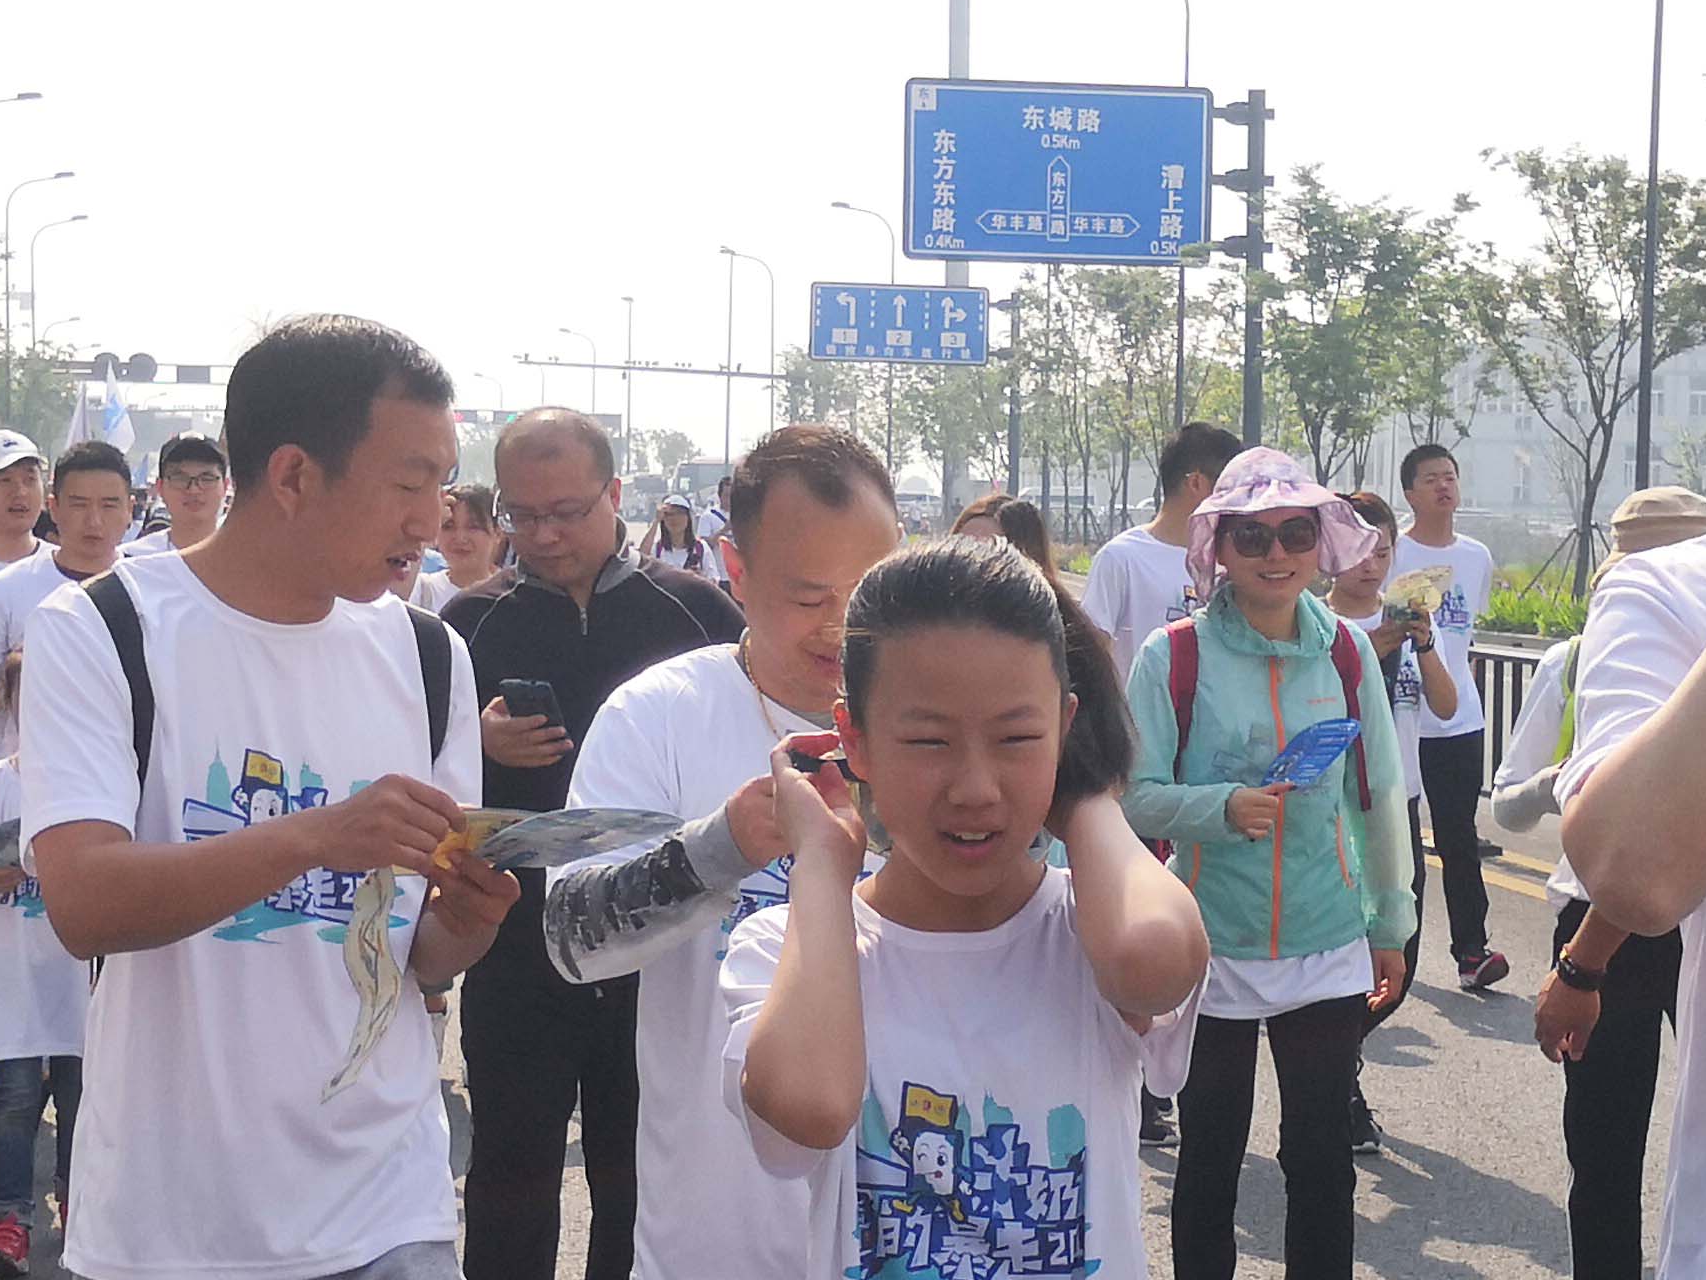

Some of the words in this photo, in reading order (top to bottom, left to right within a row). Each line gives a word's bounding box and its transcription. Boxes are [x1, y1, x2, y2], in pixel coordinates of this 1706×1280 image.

[1022, 105, 1101, 133] 东城路
[932, 129, 957, 233] 东方东路
[990, 214, 1044, 232] 华丰路
[1150, 240, 1178, 255] 0.5K
